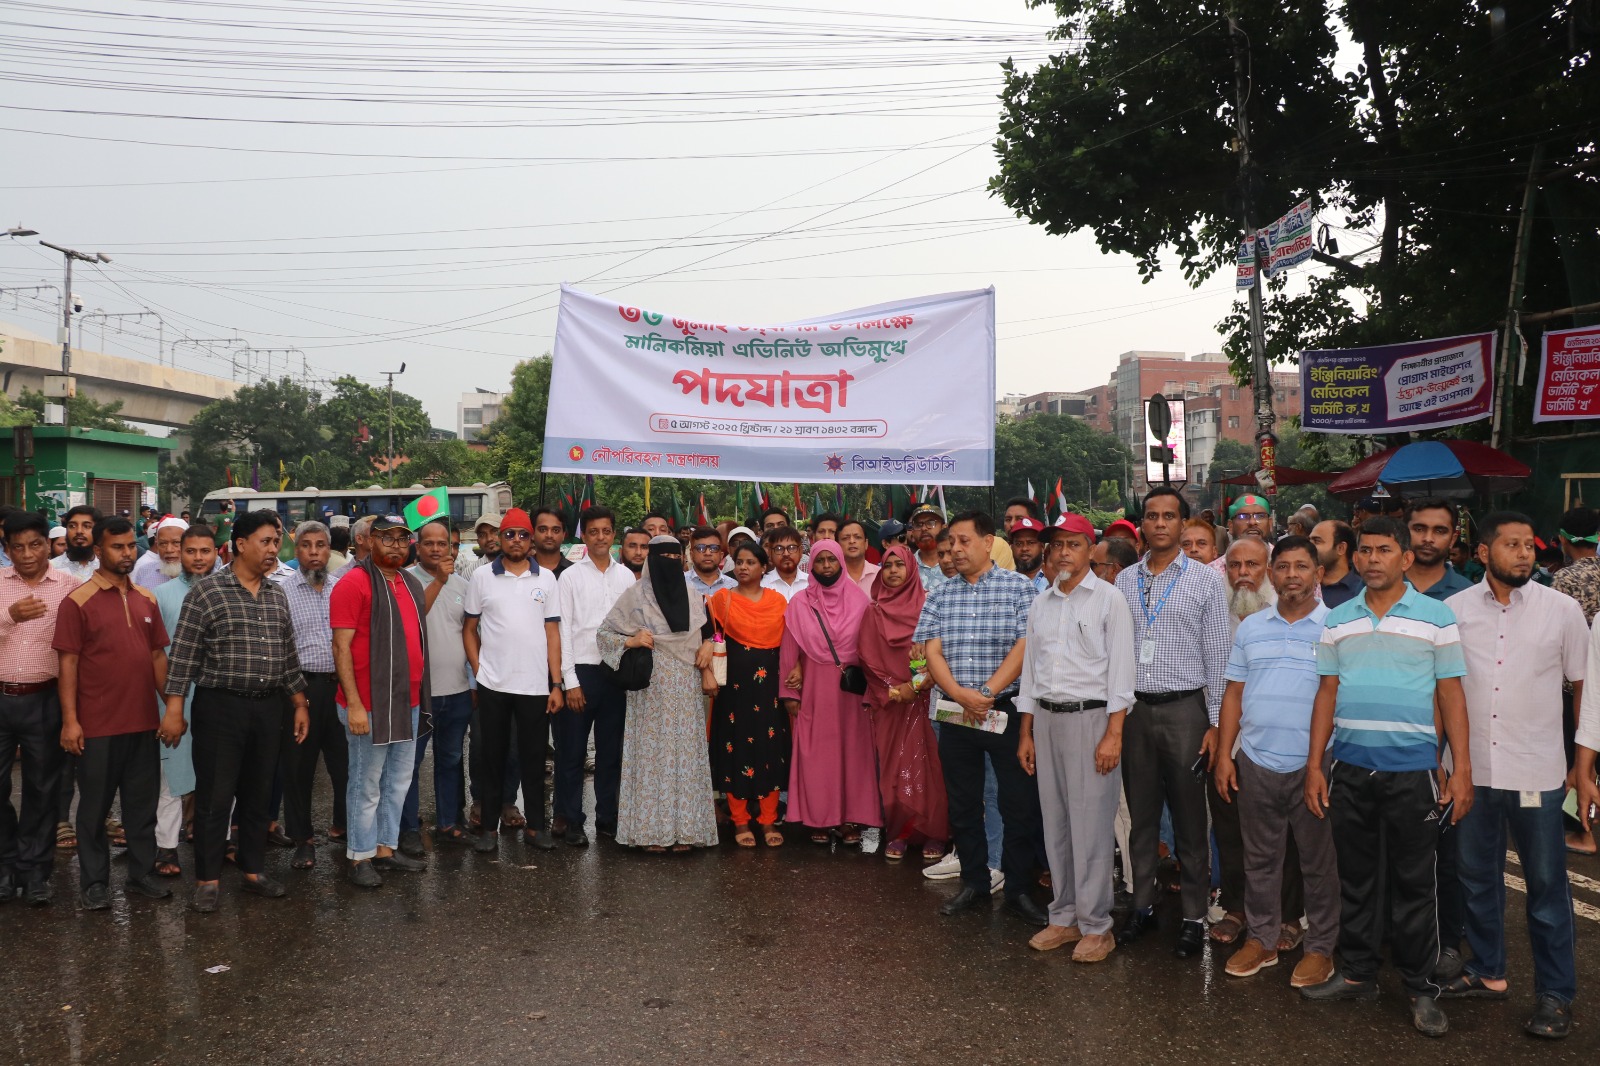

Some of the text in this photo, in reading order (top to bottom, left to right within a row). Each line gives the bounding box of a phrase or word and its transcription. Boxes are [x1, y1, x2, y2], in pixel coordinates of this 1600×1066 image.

[624, 332, 908, 363] মানিকমিয়া এভিনিউ অভিমুখে
[1401, 351, 1464, 371] শিক্ষার্থীর প্রয়োজনে
[1310, 365, 1377, 382] ইঞ্জিনিয়ারিং
[1398, 371, 1428, 386] প্রোগ্রাম
[1461, 373, 1475, 384] শুধু
[1551, 366, 1600, 382] মেডিকেল
[672, 367, 854, 413] পদযাত্রা
[1311, 383, 1369, 399] মেডিকেল
[1548, 382, 1579, 396] ভার্সিটি
[1310, 401, 1343, 415] ভার্সিটি
[1399, 400, 1423, 413] আছে
[1424, 396, 1437, 406] এই
[1546, 397, 1576, 411] ভার্সিটি
[670, 419, 677, 429] ৫
[679, 420, 710, 430] আগস্ট
[712, 423, 738, 432] ২০২৫
[780, 425, 793, 434] ২১
[795, 425, 819, 435] শ্রাবণ
[821, 426, 848, 434] ১৪৩২
[850, 425, 877, 434] বঙ্গাব্দ
[591, 445, 720, 469] নৌপরিবহন মন্ত্রণালয়
[851, 454, 957, 474] বিআইডব্লিউটিসি
